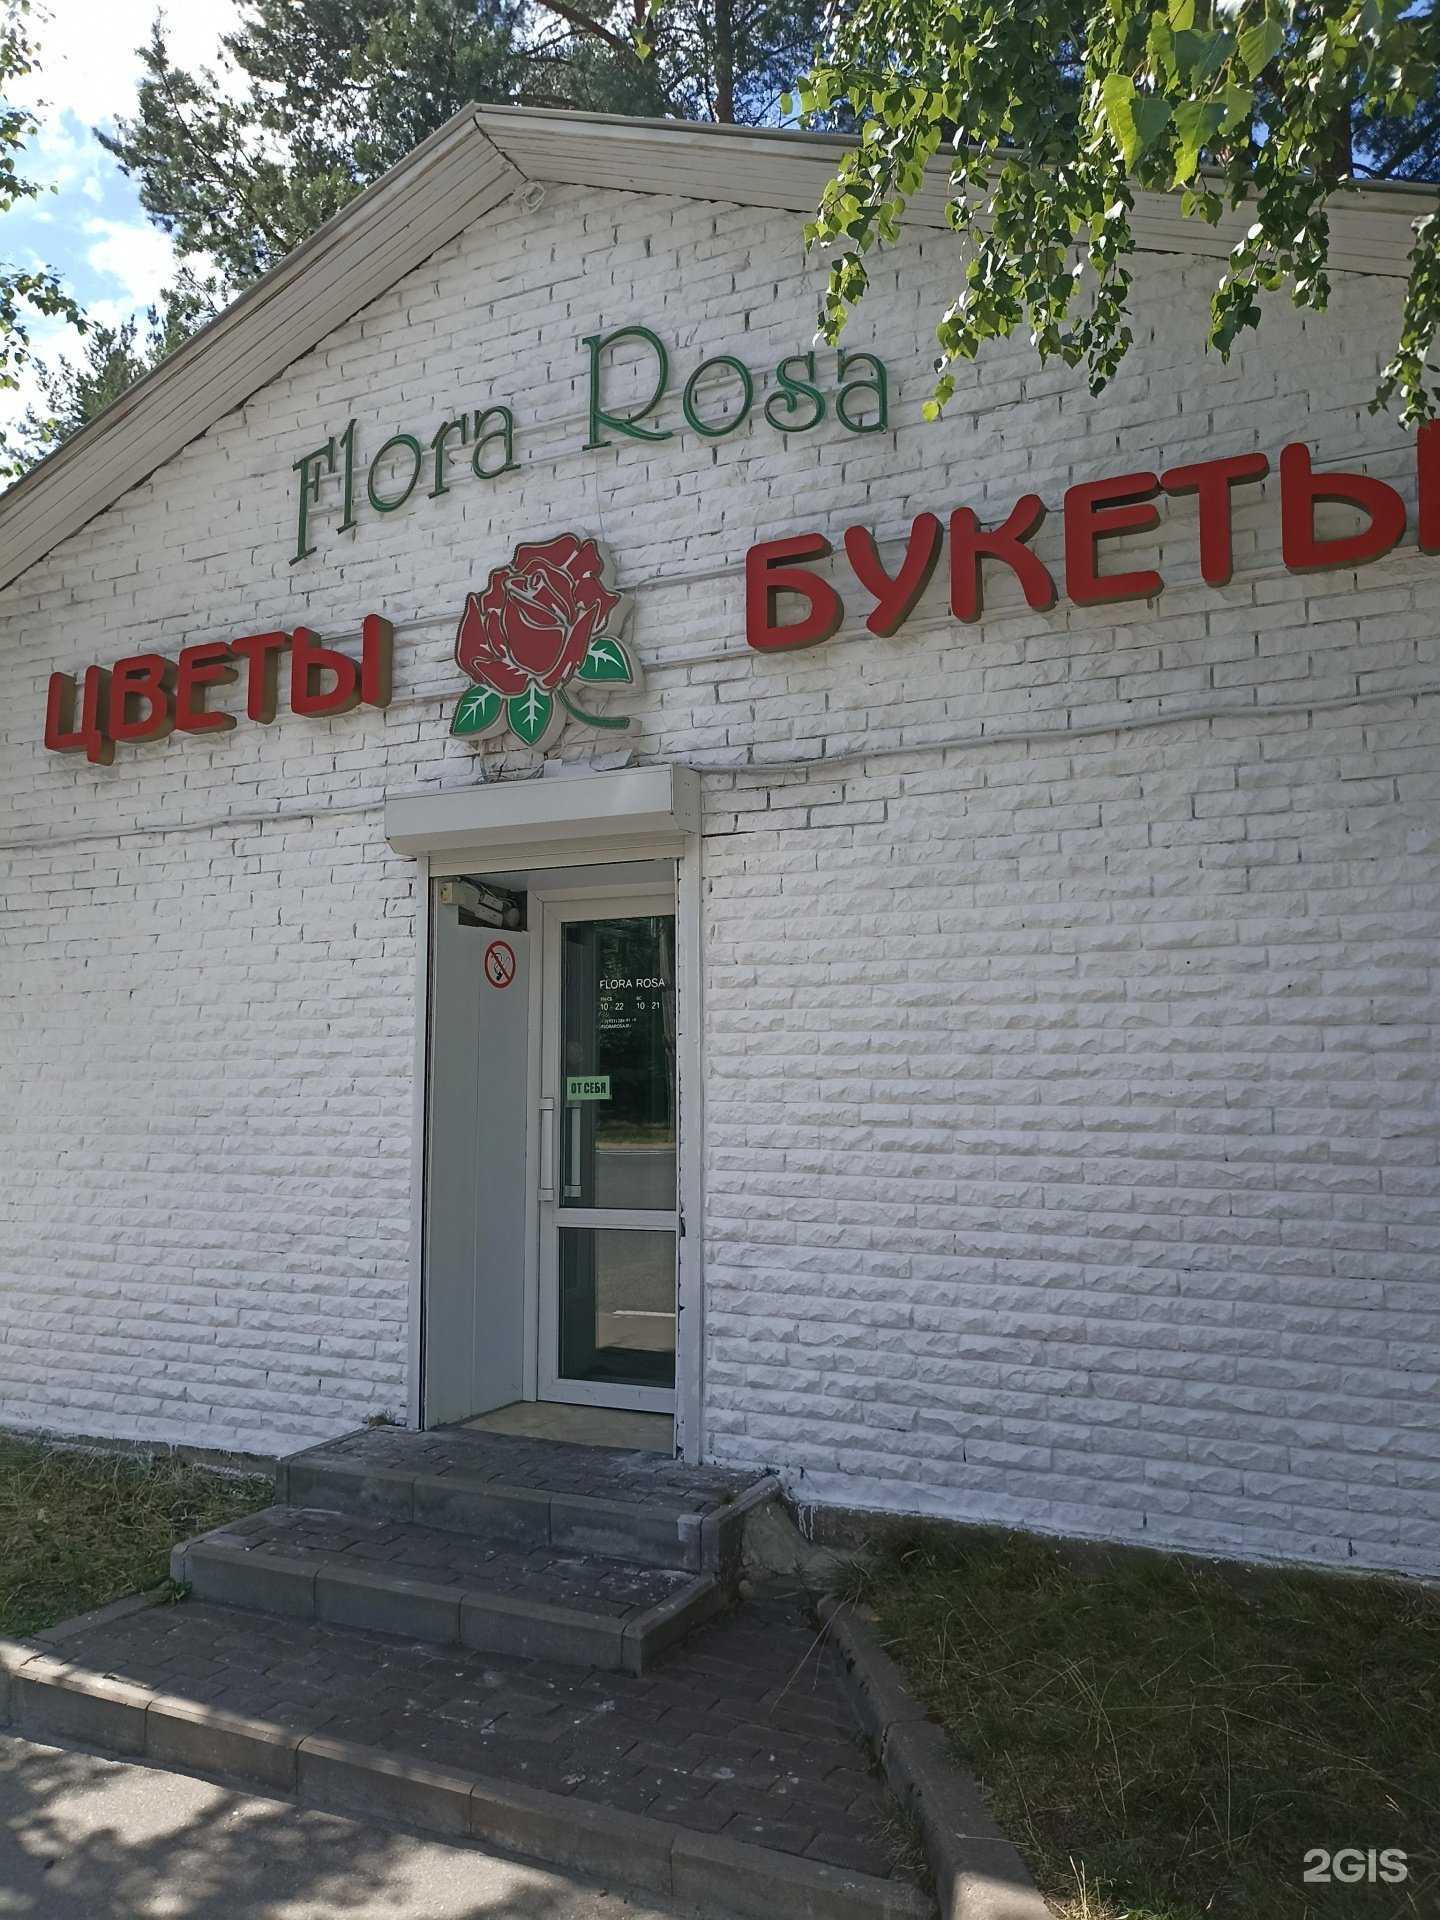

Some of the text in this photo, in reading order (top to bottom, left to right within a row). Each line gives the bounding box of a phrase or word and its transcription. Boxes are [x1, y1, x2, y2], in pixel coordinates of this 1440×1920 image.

[289, 325, 888, 566] Flora Rosa
[745, 418, 1440, 652] БУКЕТЫ
[44, 613, 393, 766] ЦВЕТЫ
[599, 977, 666, 990] FLORA ROSA
[600, 1002, 609, 1011] 10
[615, 1002, 624, 1011] 22
[636, 1001, 646, 1010] 10
[651, 1001, 660, 1010] 21
[570, 1081, 607, 1094] ОТ СЕБЯ
